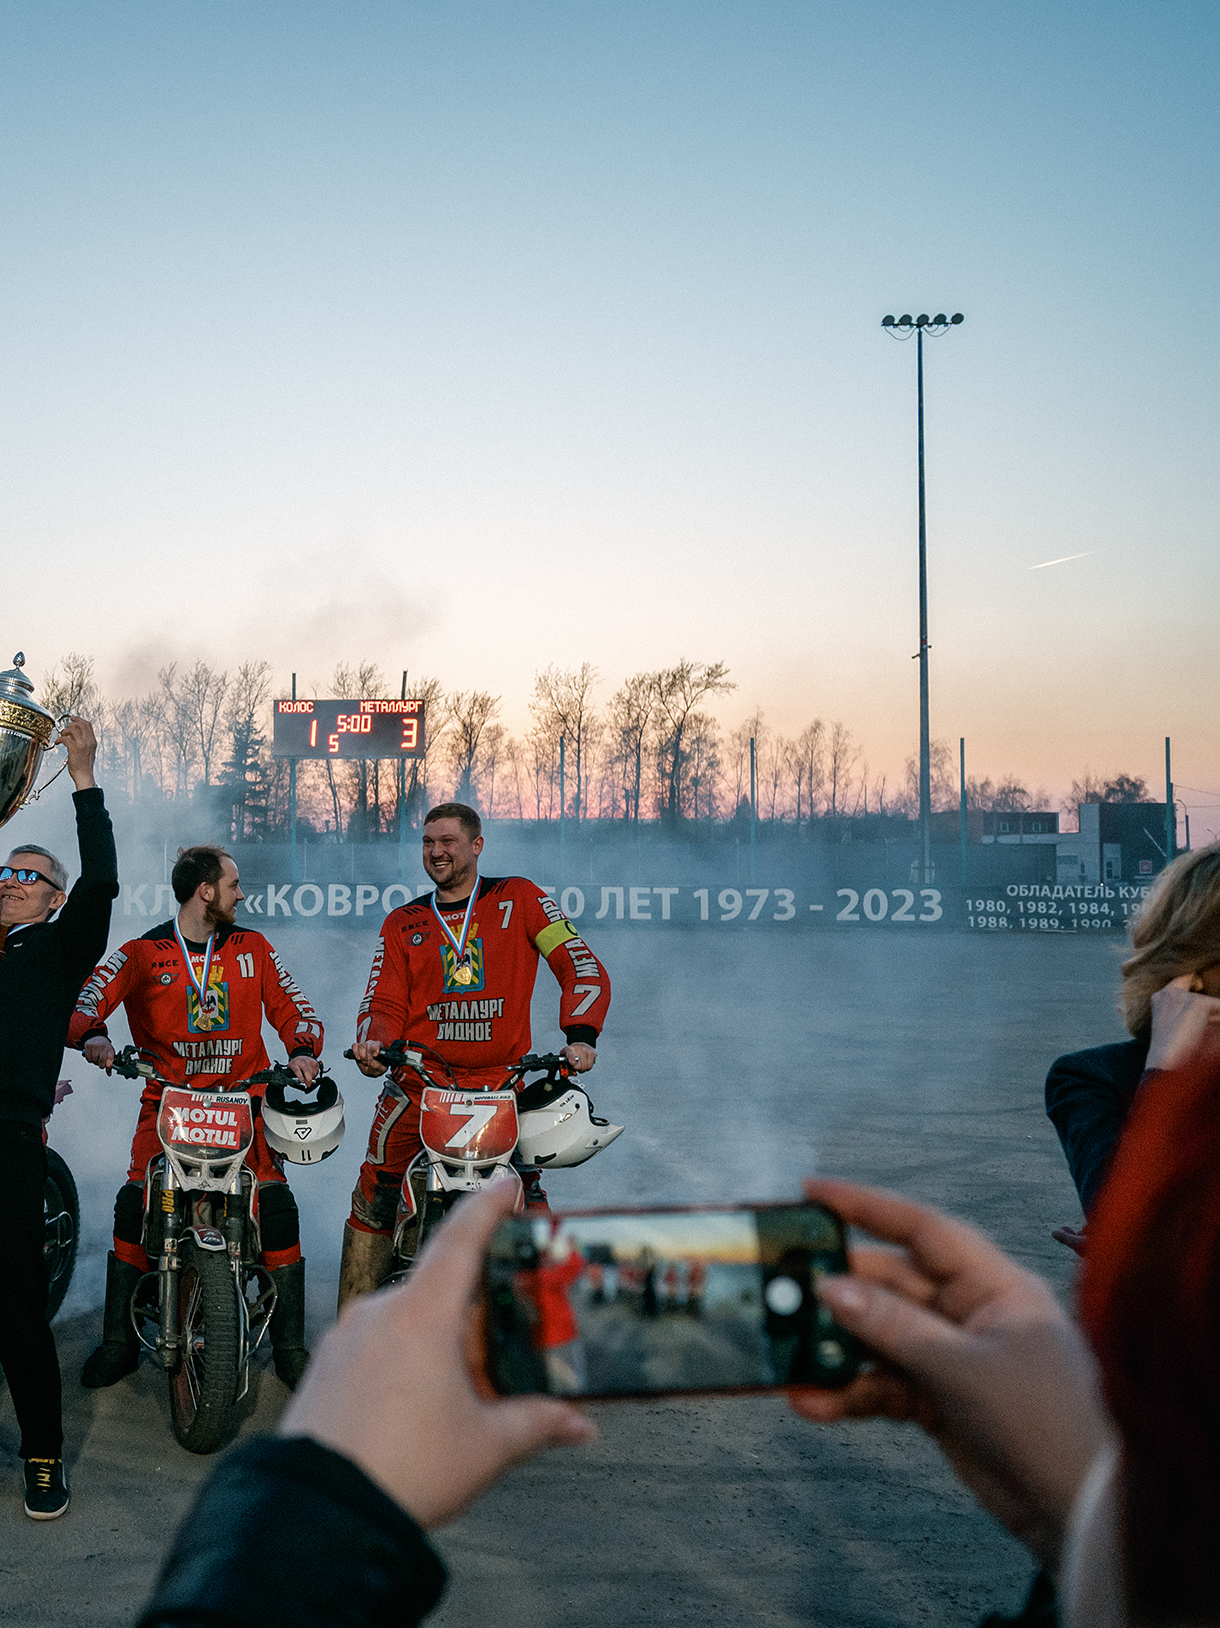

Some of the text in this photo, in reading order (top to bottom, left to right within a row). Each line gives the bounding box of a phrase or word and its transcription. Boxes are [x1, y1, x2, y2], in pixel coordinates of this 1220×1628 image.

[279, 701, 314, 713] КОЛОС
[360, 701, 422, 713] МЕТАЛЛУРГ
[309, 719, 318, 747] 1
[337, 714, 372, 733] 5:00
[401, 717, 418, 748] 3
[328, 734, 340, 752] 5
[1006, 884, 1151, 900] ОБЛАДАТЕЛЬ КУБ
[498, 900, 514, 929] 7
[595, 887, 679, 920] ЛЕТ
[692, 888, 796, 921] 1973
[836, 888, 943, 922] 2023
[966, 899, 1011, 914] 1980,
[1017, 901, 1063, 915] 1982,
[1069, 902, 1115, 917] 1984,
[236, 952, 255, 978] 11
[426, 997, 505, 1021] МЕТАЛЛУРГ
[569, 984, 602, 1017] 7
[436, 1021, 492, 1042] ВИДНОЕ
[172, 1038, 244, 1059] МЕТАЛЛУРГ
[185, 1057, 234, 1076] ВИДНОЕ
[216, 1095, 248, 1105] RUSANOV
[171, 1106, 238, 1126] MOTUL
[444, 1104, 499, 1148] 7
[171, 1126, 237, 1147] MOTUL
[301, 1149, 312, 1162] 11
